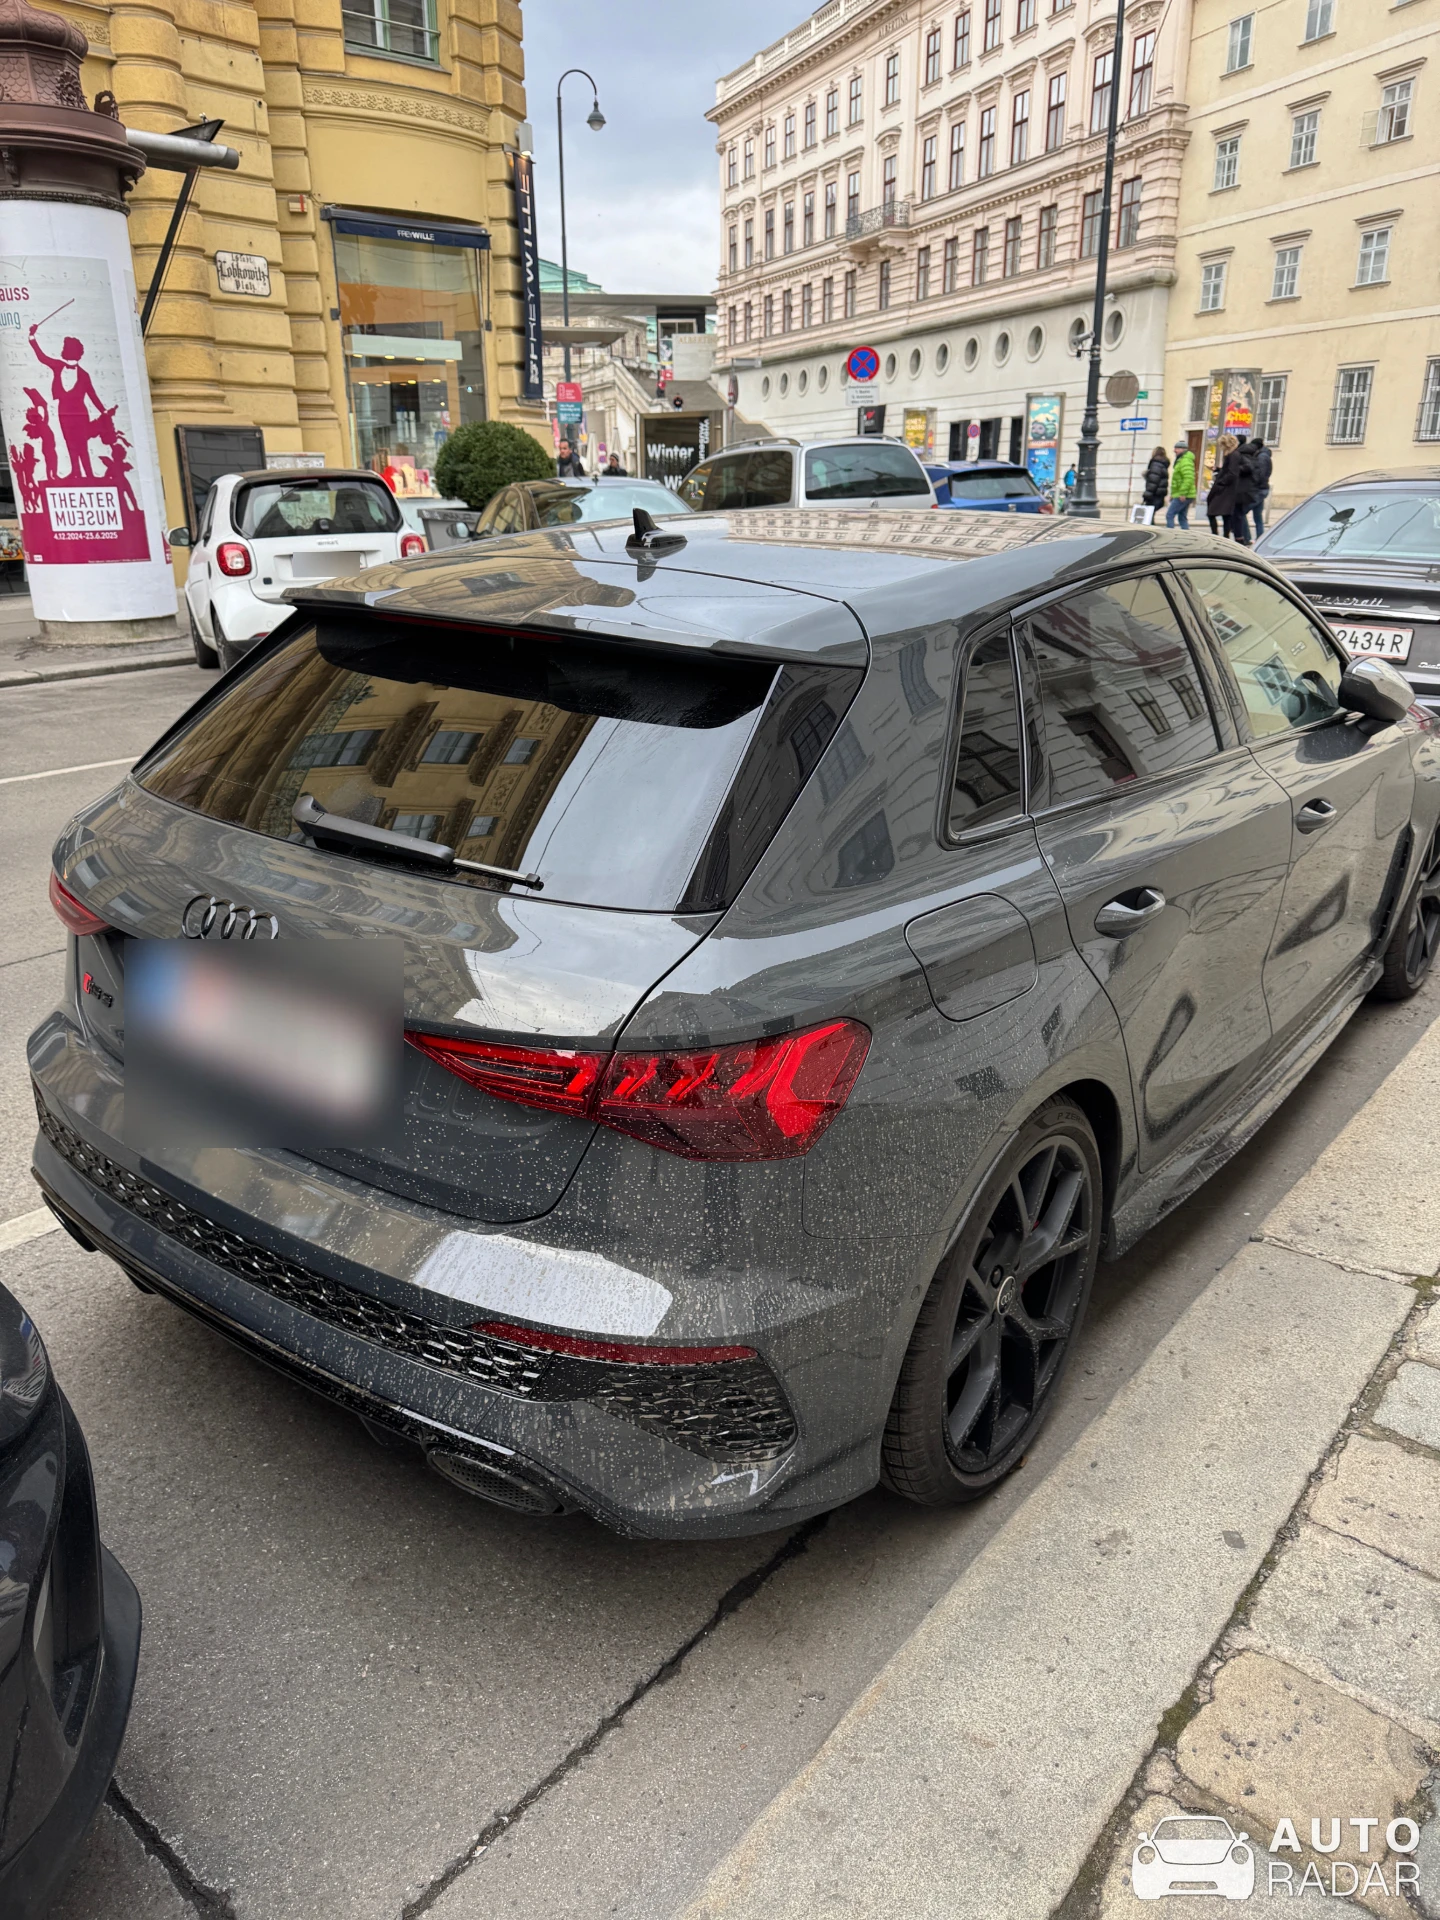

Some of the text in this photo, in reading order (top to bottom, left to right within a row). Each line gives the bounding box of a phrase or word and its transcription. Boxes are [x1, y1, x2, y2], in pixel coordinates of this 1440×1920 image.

[397, 229, 435, 241] FREYWILLE
[647, 443, 695, 460] Winter
[50, 492, 115, 508] THEATER
